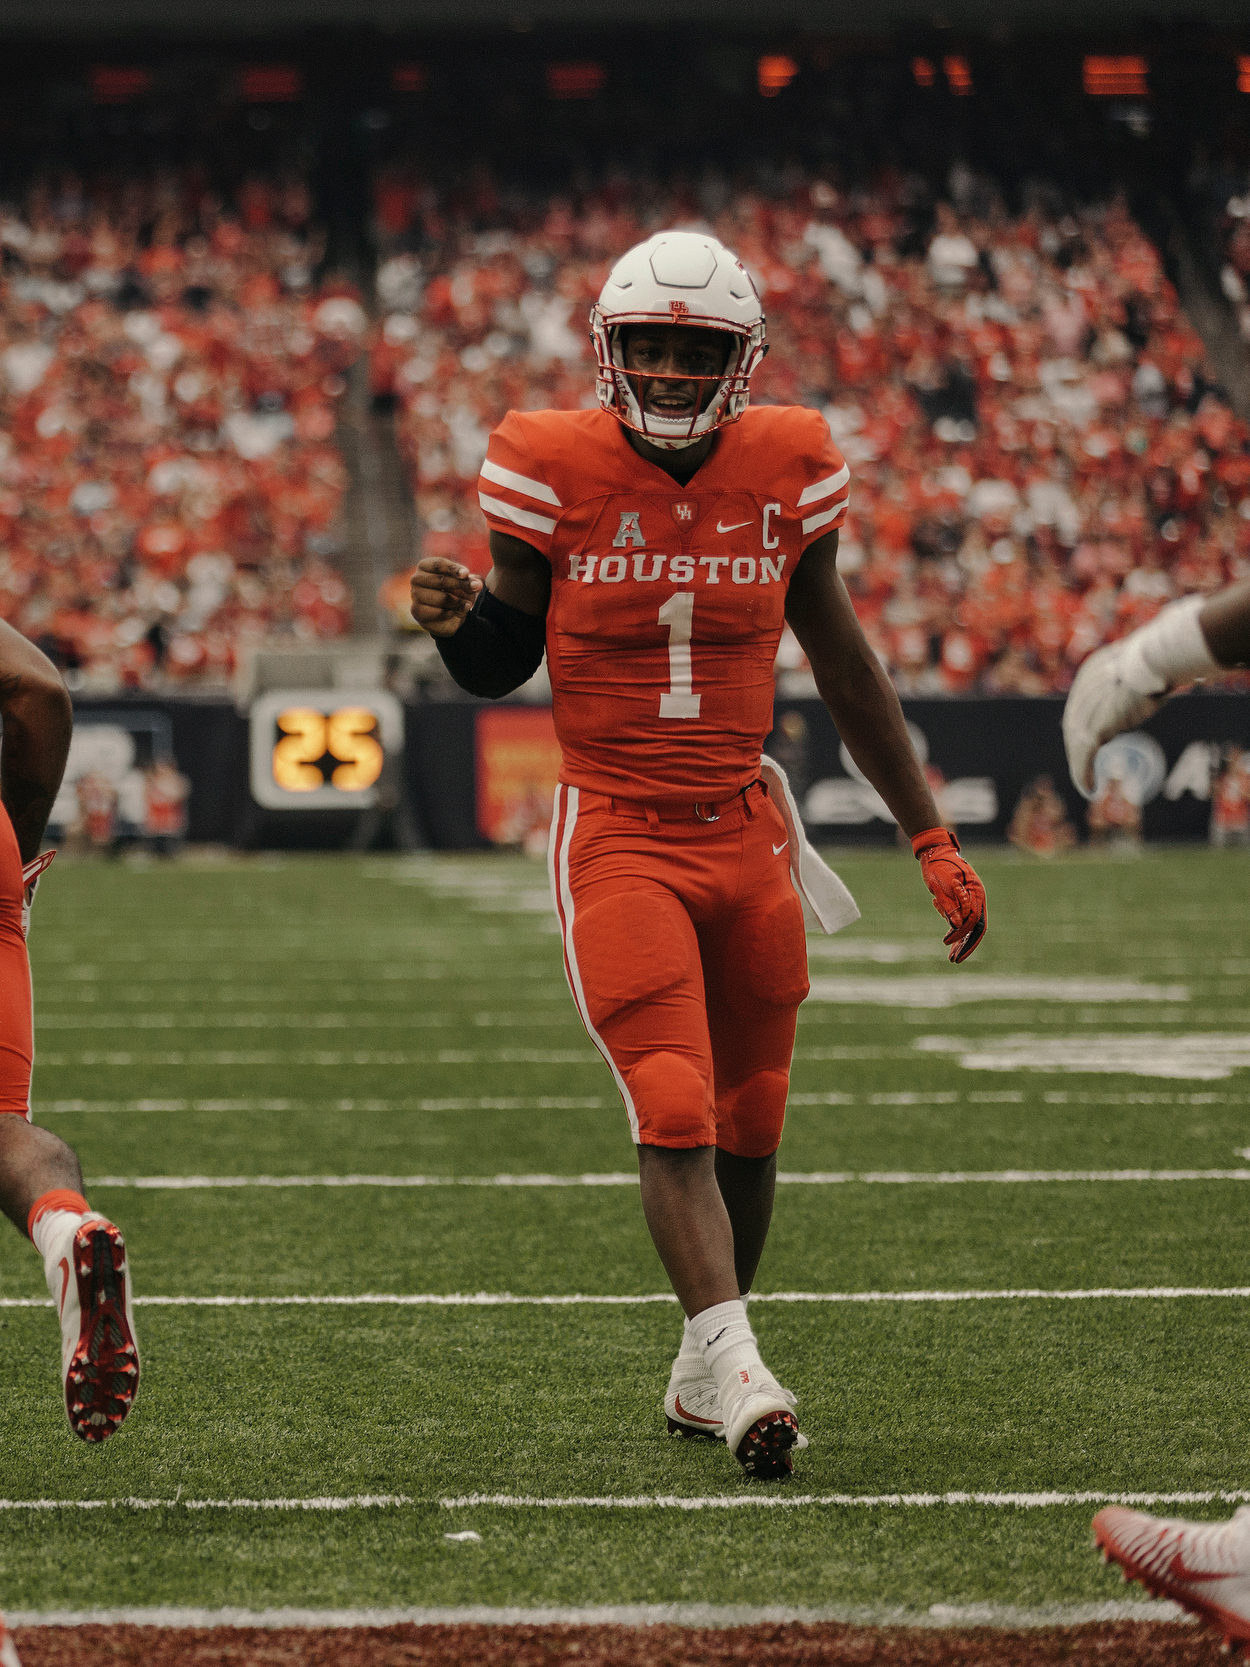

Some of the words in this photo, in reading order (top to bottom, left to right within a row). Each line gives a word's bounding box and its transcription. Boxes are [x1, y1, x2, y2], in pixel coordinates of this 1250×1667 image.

[612, 511, 646, 548] A
[676, 504, 692, 520] UH
[763, 503, 781, 550] C
[567, 554, 787, 585] HOUSTON
[658, 592, 701, 719] 1
[272, 706, 385, 793] 25
